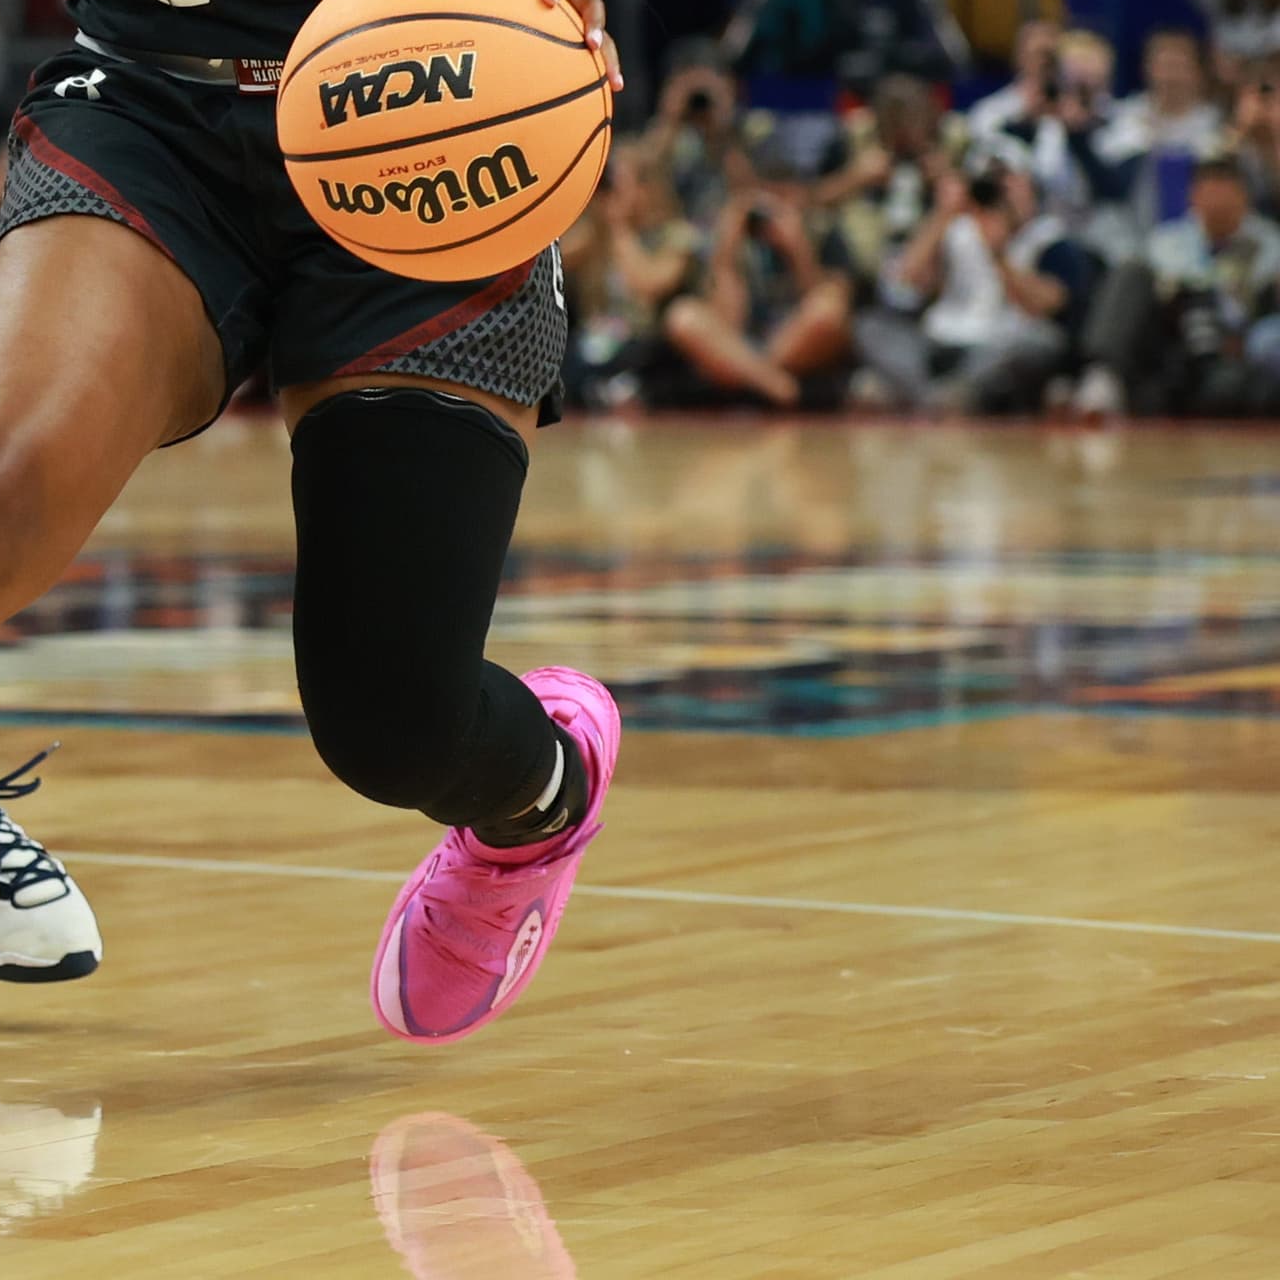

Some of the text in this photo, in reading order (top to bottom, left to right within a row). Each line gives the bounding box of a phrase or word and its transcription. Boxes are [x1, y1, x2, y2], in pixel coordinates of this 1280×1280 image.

[320, 39, 475, 73] OFFICIAL GAME BALL
[252, 68, 282, 82] OUTH
[318, 52, 476, 128] NCAA
[317, 143, 539, 224] Wilson
[378, 155, 447, 178] EVO NXT
